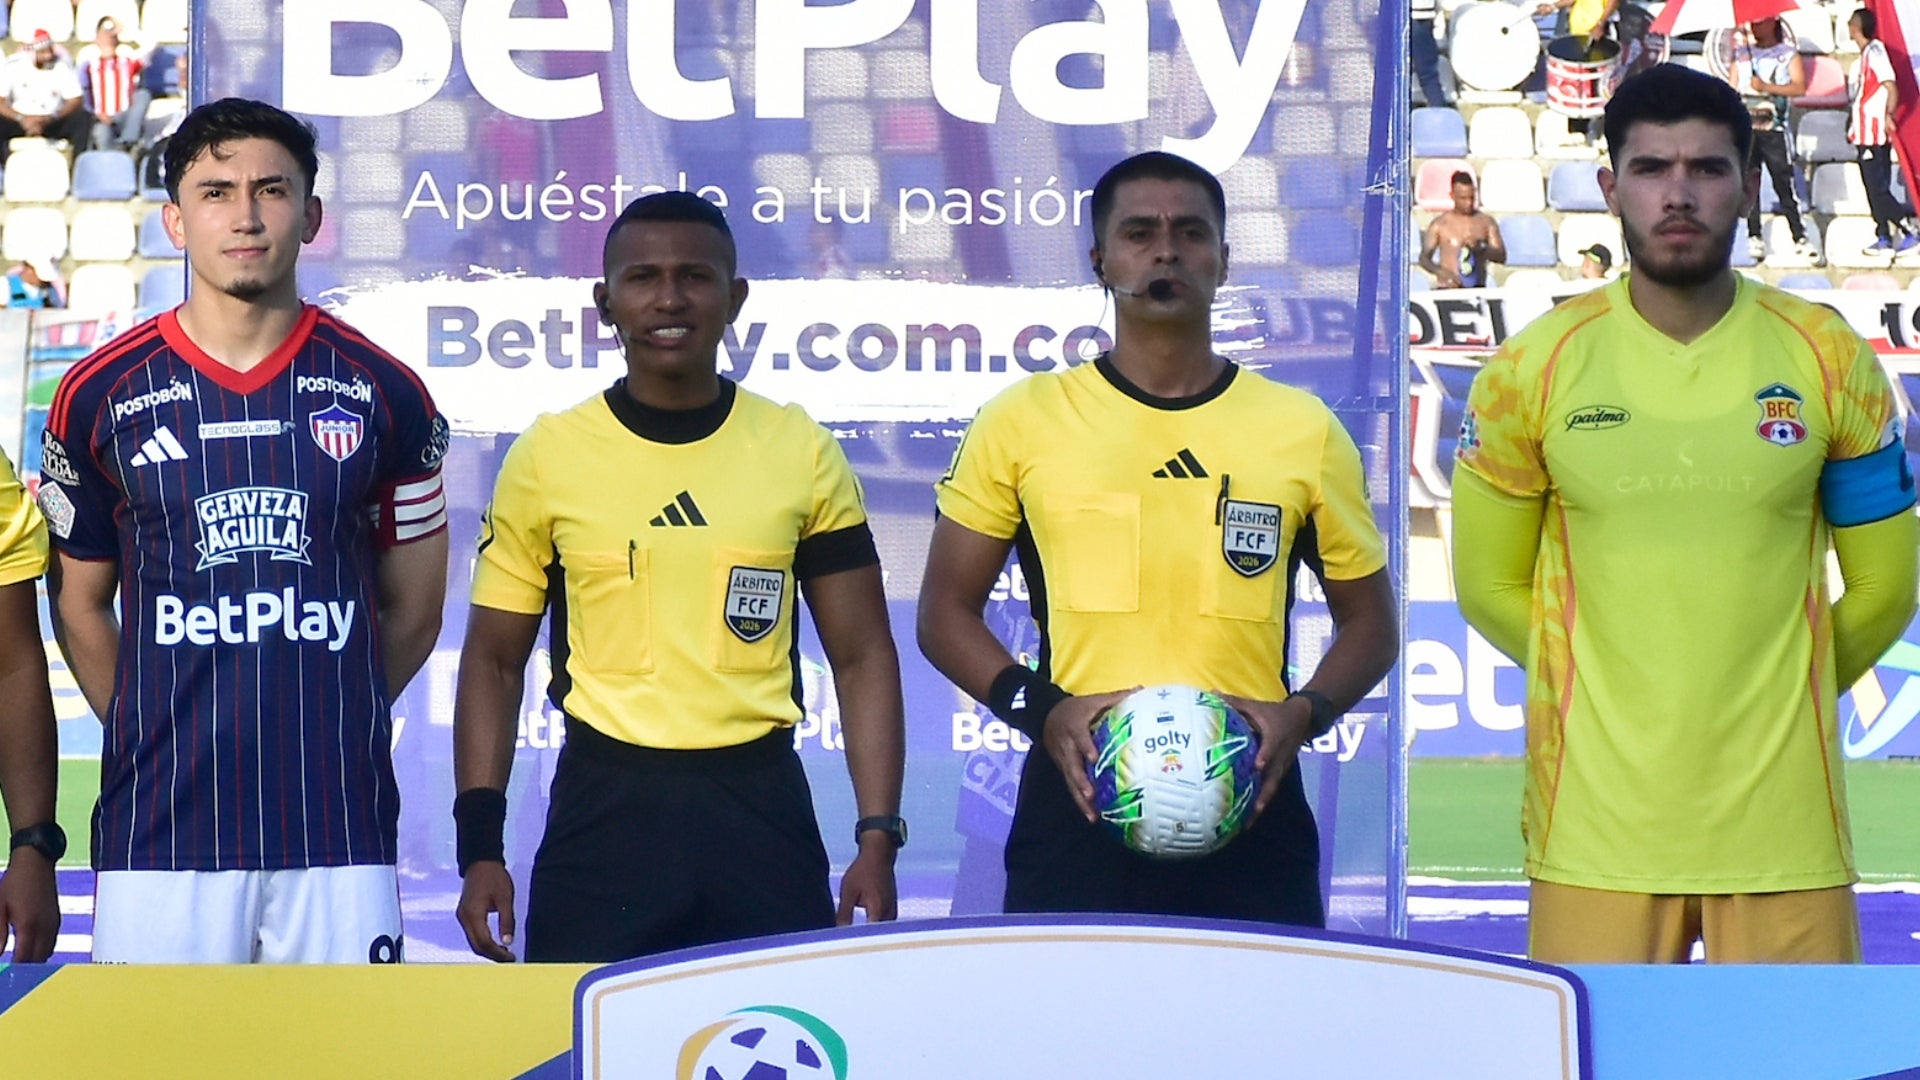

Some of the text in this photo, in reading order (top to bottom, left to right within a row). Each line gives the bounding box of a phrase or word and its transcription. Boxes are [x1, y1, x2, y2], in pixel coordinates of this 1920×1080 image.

[751, 184, 785, 224] a
[810, 176, 871, 225] tu
[1565, 408, 1626, 432] padma
[1766, 401, 1797, 420] BFC
[319, 424, 355, 434] JUNIOR
[1615, 475, 1756, 494] CATAPULT
[1235, 530, 1266, 549] FCF
[1238, 556, 1260, 567] 2026
[737, 596, 768, 615] FCF
[155, 586, 356, 652] BetPlay
[739, 620, 761, 632] 2026
[1144, 730, 1192, 754] golty
